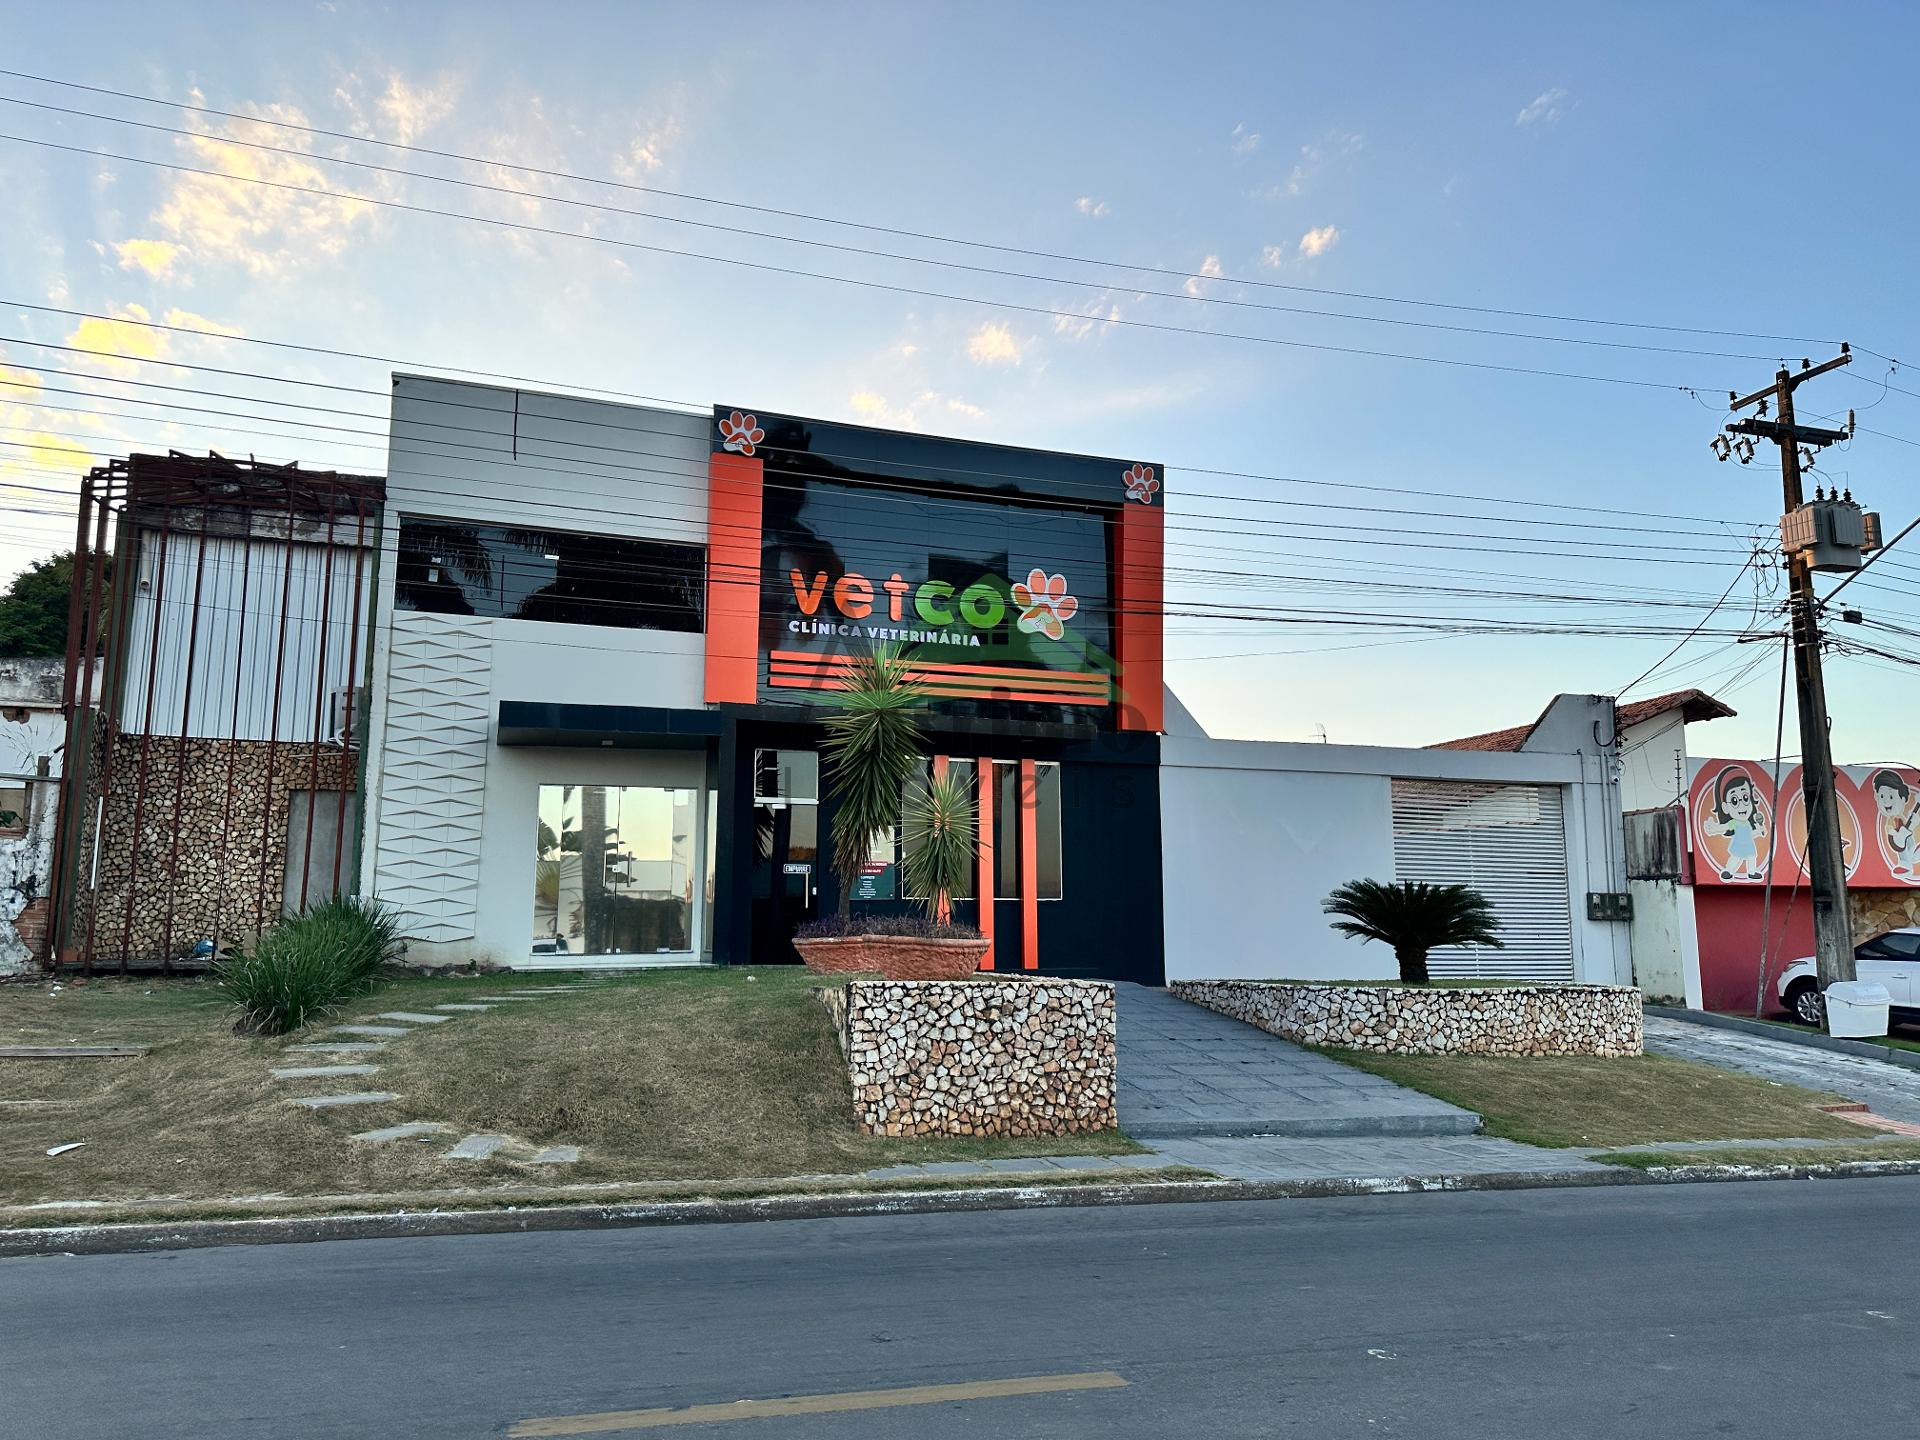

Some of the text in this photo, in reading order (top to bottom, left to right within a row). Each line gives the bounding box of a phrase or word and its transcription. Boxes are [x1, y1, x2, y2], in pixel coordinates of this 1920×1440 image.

[789, 567, 1006, 629] vetco
[788, 618, 981, 648] CLÍNICA VETERINÁRIA
